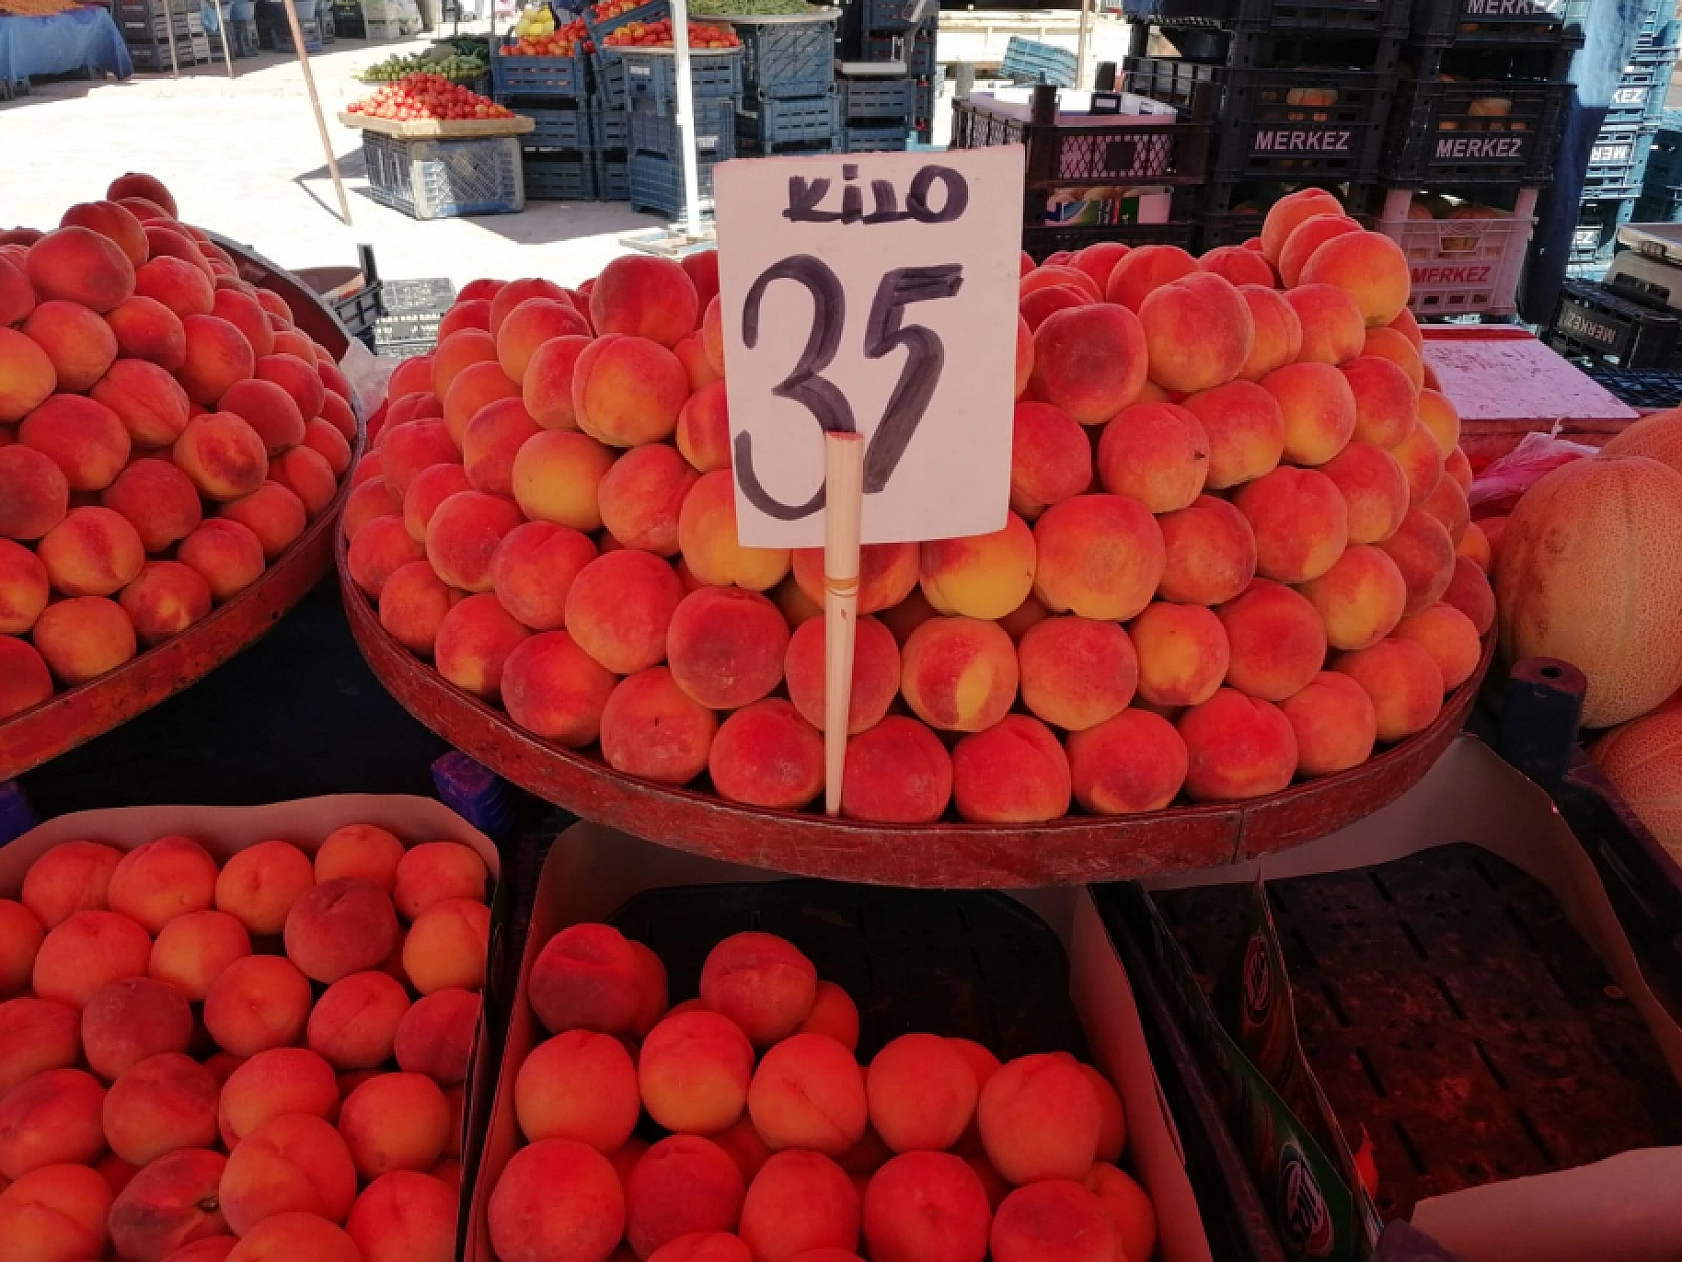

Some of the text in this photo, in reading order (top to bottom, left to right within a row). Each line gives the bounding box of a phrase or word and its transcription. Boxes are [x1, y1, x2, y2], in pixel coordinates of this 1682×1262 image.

[1255, 130, 1351, 151] MERKEZ
[1436, 137, 1523, 158] MERKEZ
[1411, 265, 1492, 283] MERKEZ
[733, 253, 965, 521] 35
